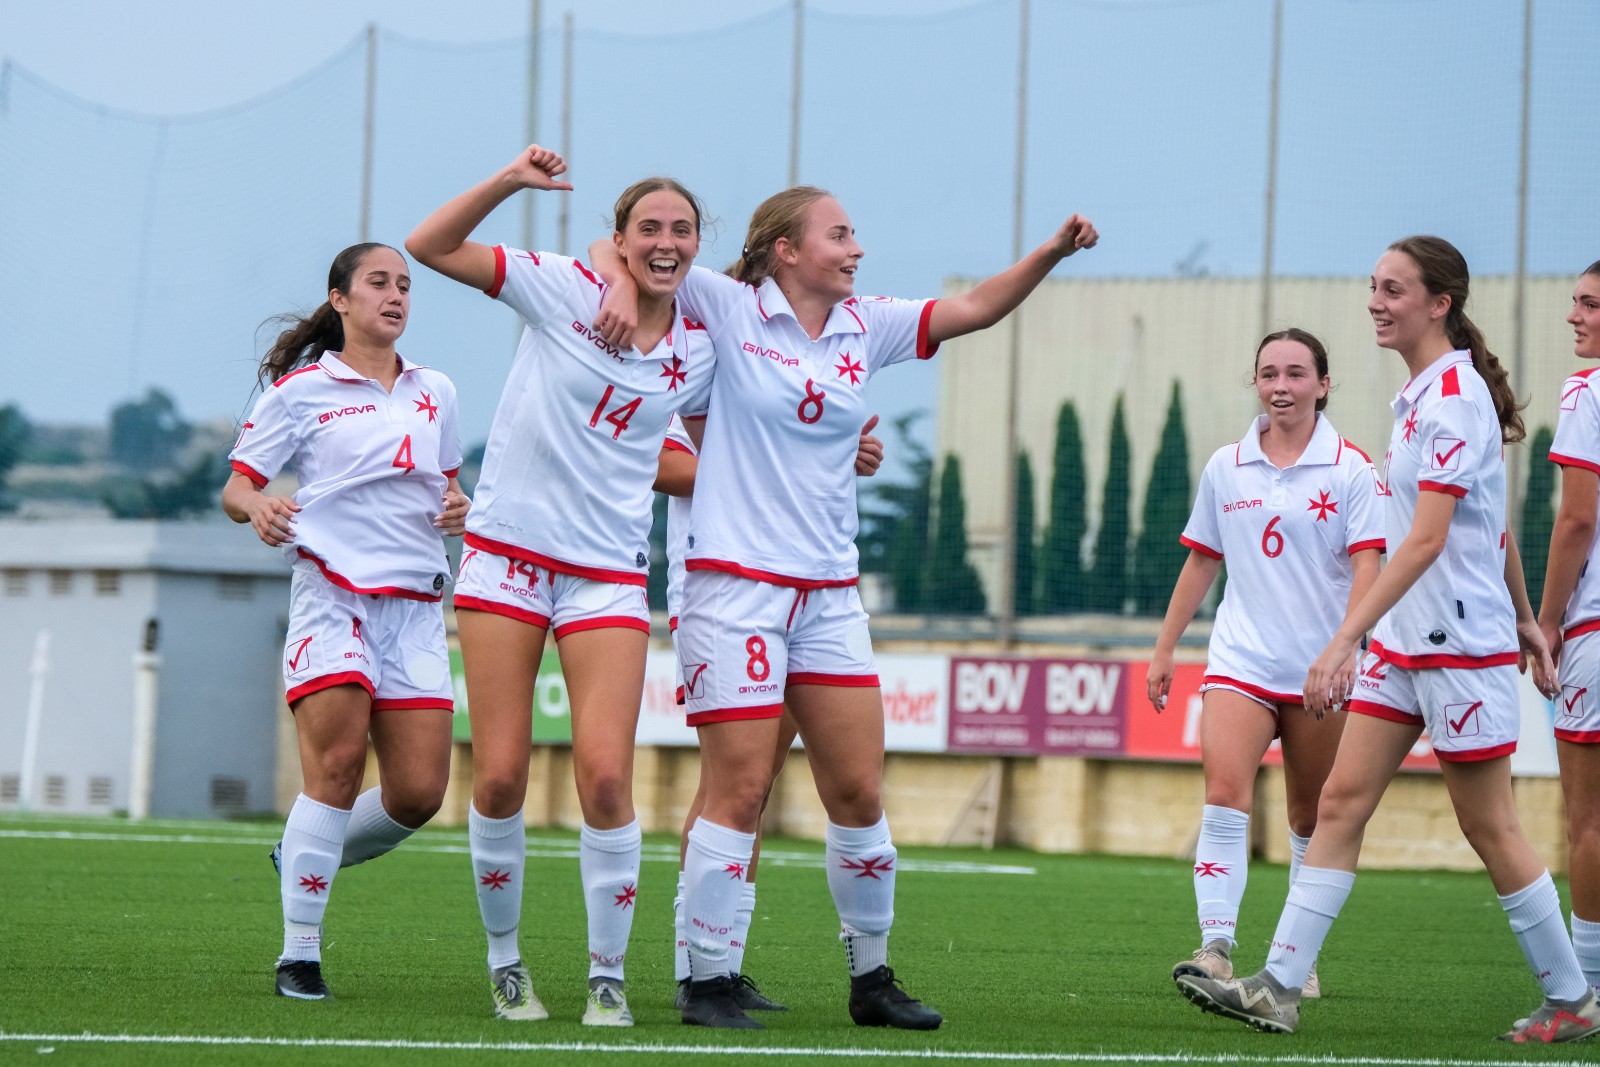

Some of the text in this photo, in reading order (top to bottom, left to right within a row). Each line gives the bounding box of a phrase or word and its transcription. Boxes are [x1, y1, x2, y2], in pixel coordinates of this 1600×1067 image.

[743, 342, 799, 367] GIVOVA
[318, 404, 377, 424] GIVOVA
[589, 384, 643, 440] 14
[798, 378, 826, 424] 8
[392, 434, 415, 475] 4
[1223, 499, 1263, 513] GIVOVA
[1262, 515, 1284, 558] 6
[500, 582, 540, 599] GIVOVA
[507, 557, 540, 591] 14
[745, 635, 770, 682] 8
[738, 684, 778, 693] GIVOVA
[955, 662, 1031, 714] BOV
[1045, 663, 1121, 715] BOV
